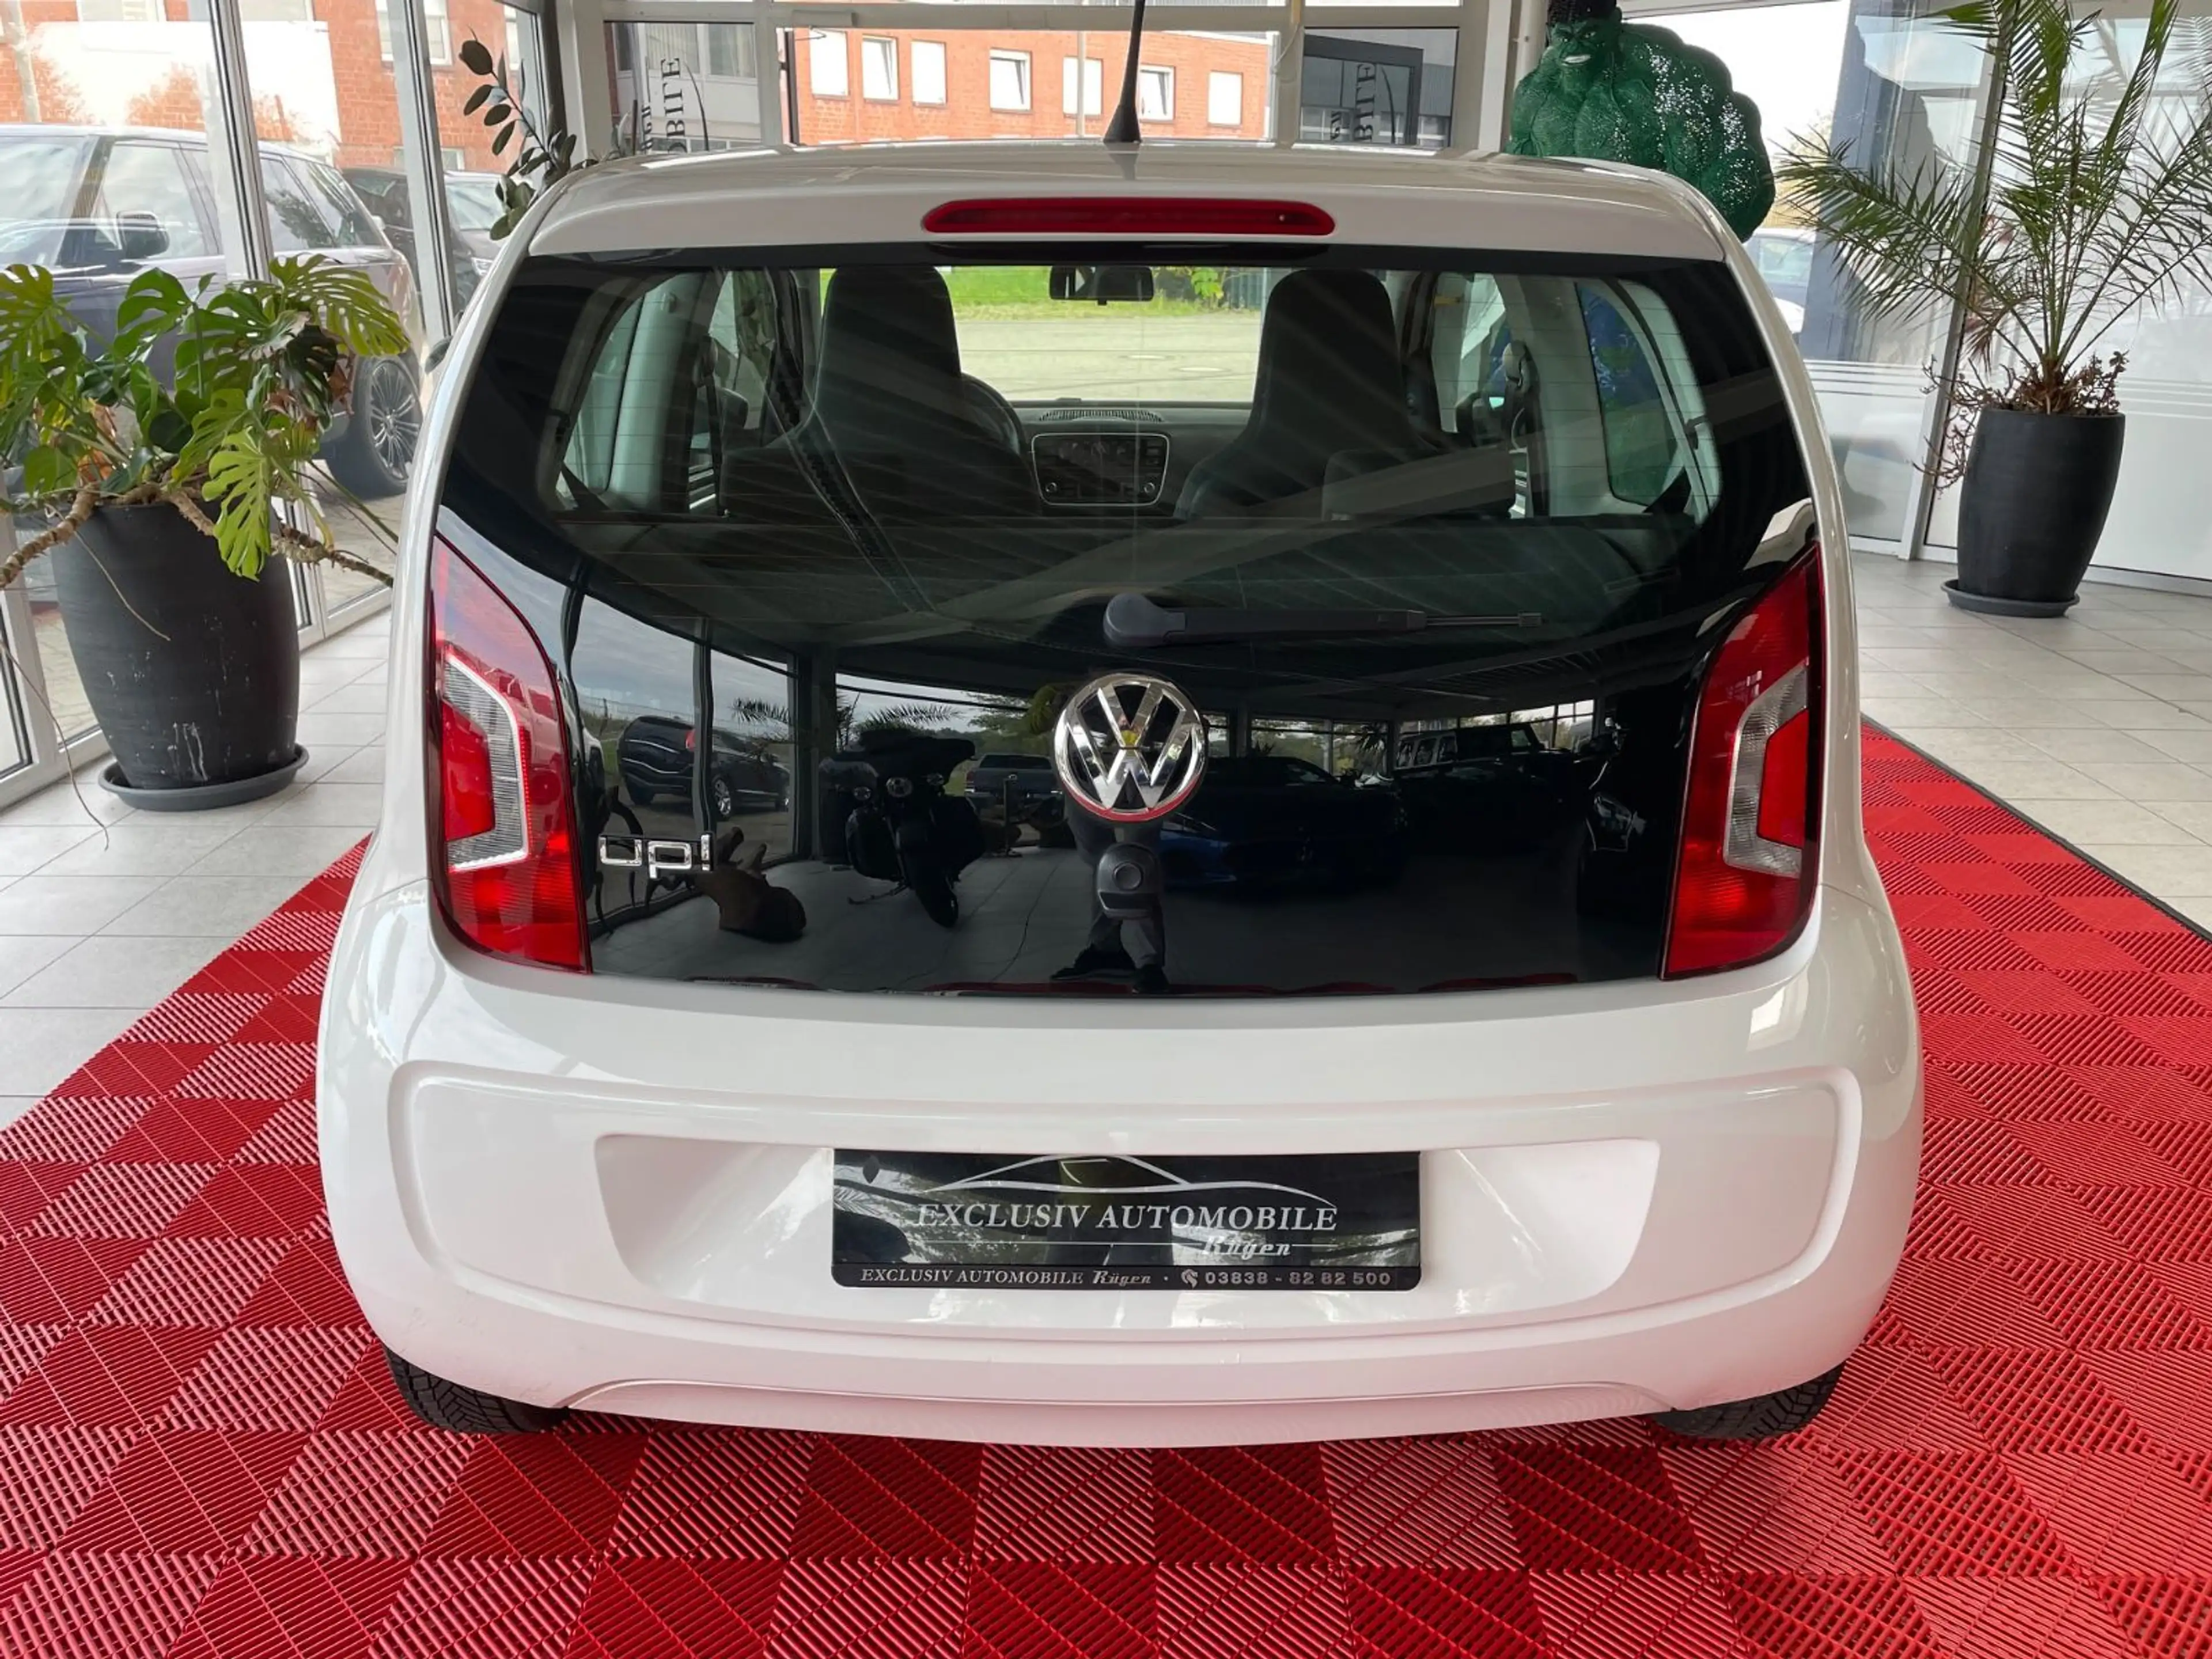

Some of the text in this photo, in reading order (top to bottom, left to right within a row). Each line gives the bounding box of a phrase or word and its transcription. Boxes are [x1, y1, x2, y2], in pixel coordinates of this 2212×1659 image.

[1054, 673, 1209, 821] VW
[599, 834, 711, 878] up!
[915, 1203, 1337, 1231] EXCLUSIV AUTOMOBILE
[860, 1268, 953, 1282] EXCLUSIV
[955, 1270, 1084, 1284] AUTOMOBILE
[1092, 1270, 1152, 1287] Rügen
[1205, 1272, 1268, 1285] 03838
[1289, 1272, 1314, 1285] 82
[1320, 1272, 1346, 1285] 82
[1352, 1272, 1391, 1285] 500
